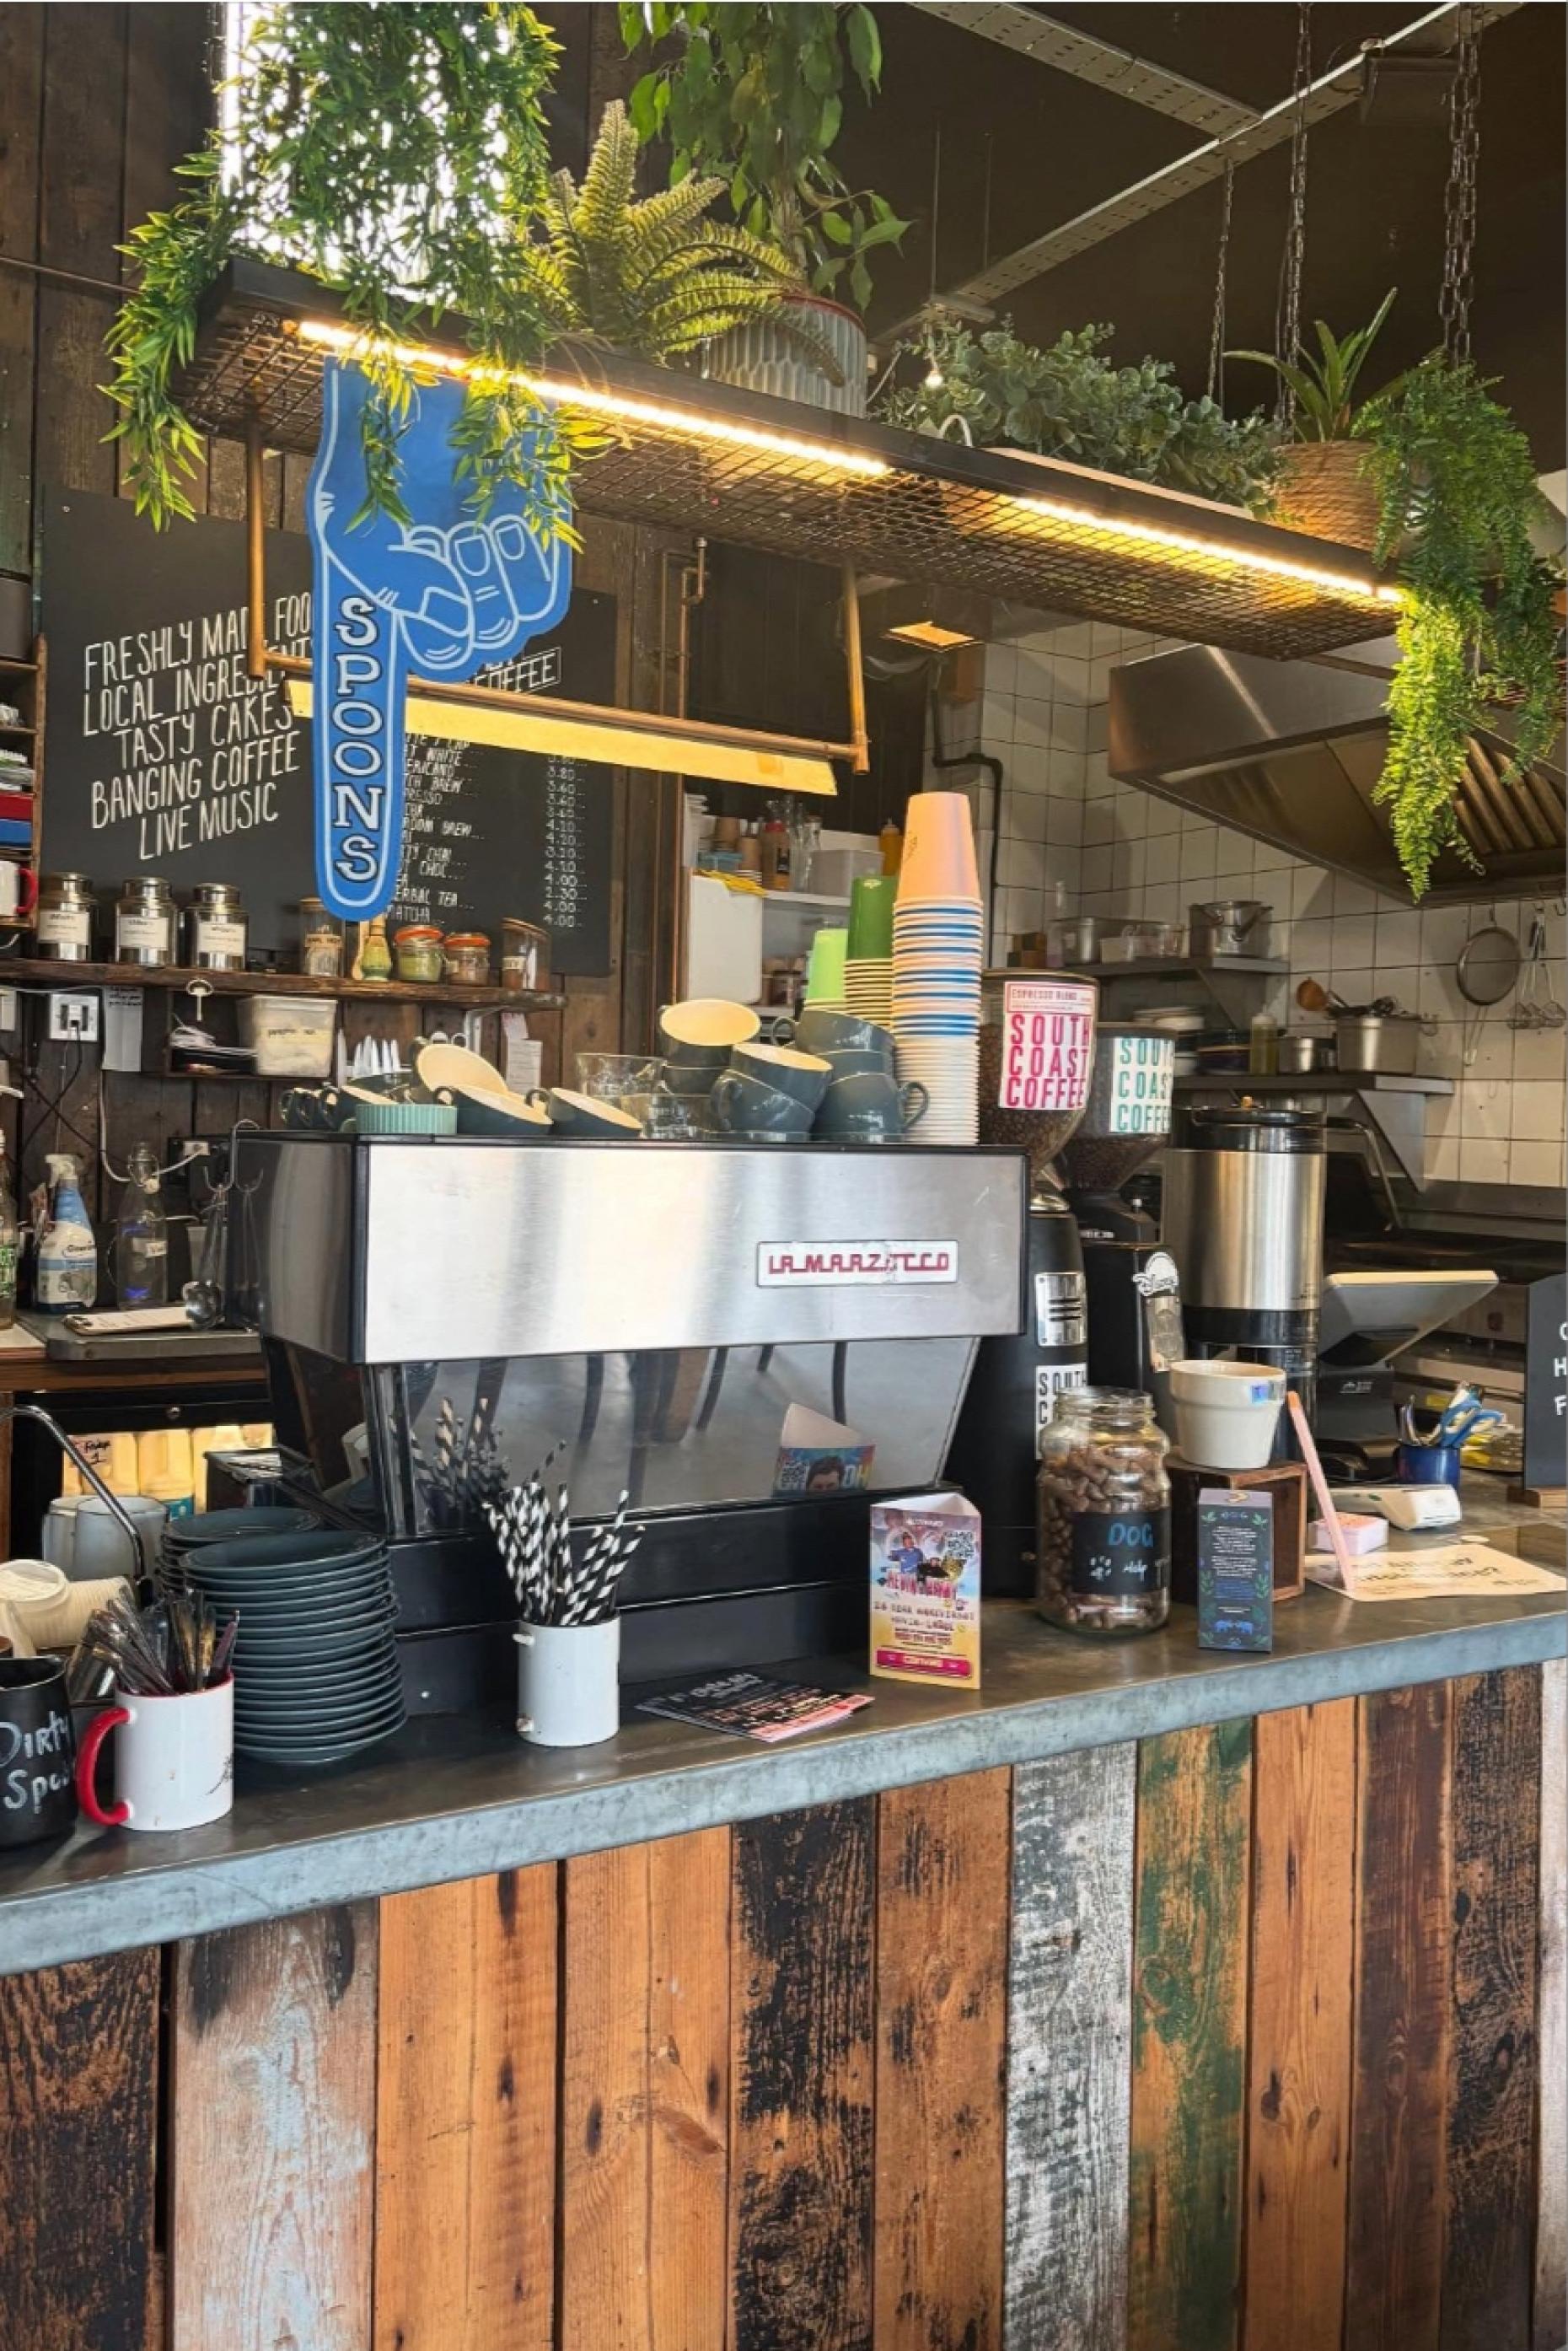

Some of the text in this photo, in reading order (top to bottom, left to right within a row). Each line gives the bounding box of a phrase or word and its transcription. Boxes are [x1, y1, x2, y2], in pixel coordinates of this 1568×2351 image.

[85, 621, 193, 690] FRESHLY
[202, 606, 250, 659] MA
[83, 678, 164, 738] LOCAL
[113, 712, 196, 770] TASTY
[333, 596, 385, 882] SPOONS
[91, 730, 300, 830] BANGING COFFEE
[139, 782, 279, 861] LIVE MUSIC
[1011, 1013, 1092, 1046] SOUTH
[1008, 1045, 1089, 1079] COAST
[1006, 1075, 1087, 1110] COFFEE
[1109, 1521, 1153, 1547] DOG
